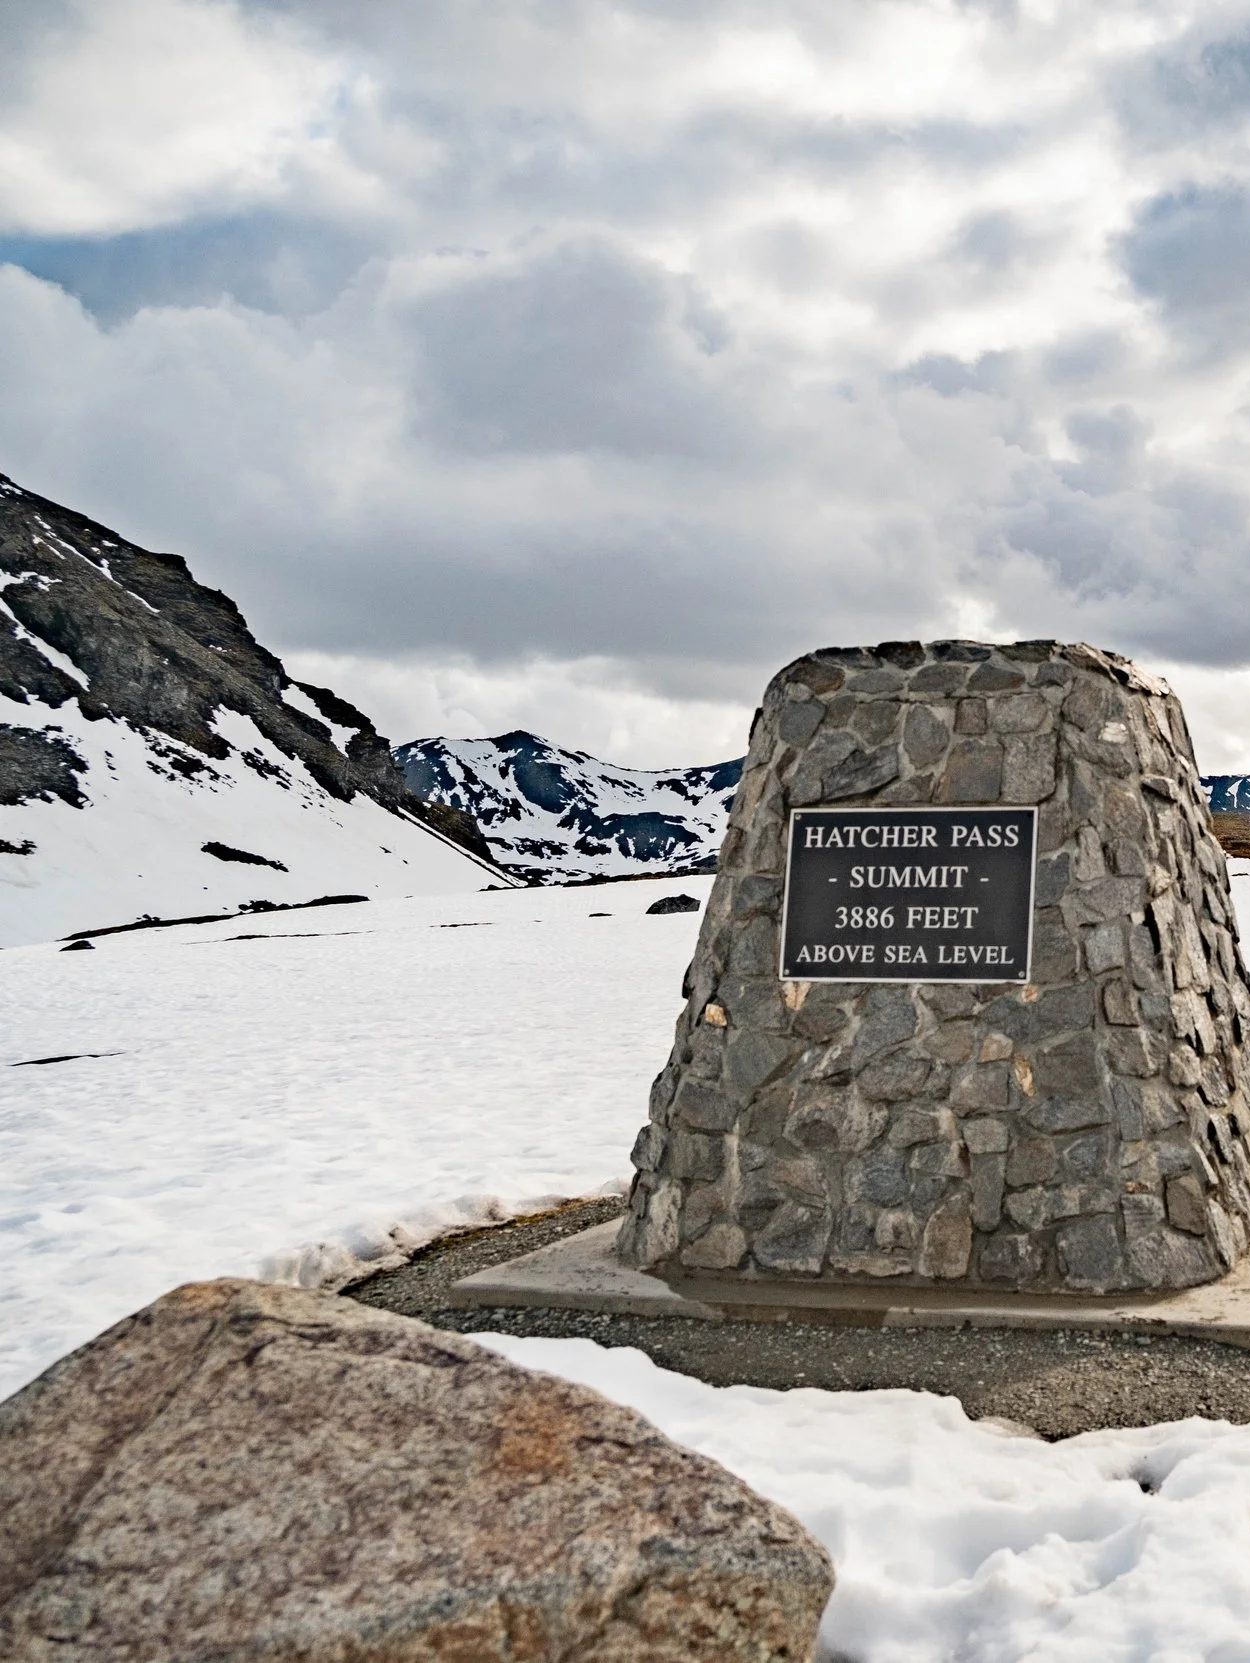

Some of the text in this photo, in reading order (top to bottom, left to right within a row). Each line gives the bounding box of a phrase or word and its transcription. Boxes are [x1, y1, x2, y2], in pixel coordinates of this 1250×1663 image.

[805, 825, 1018, 847] HATCHER PASS
[850, 866, 968, 888] SUMMIT
[835, 907, 978, 928] 3886 FEET
[797, 945, 1014, 964] ABOVE SEA LEVEL
